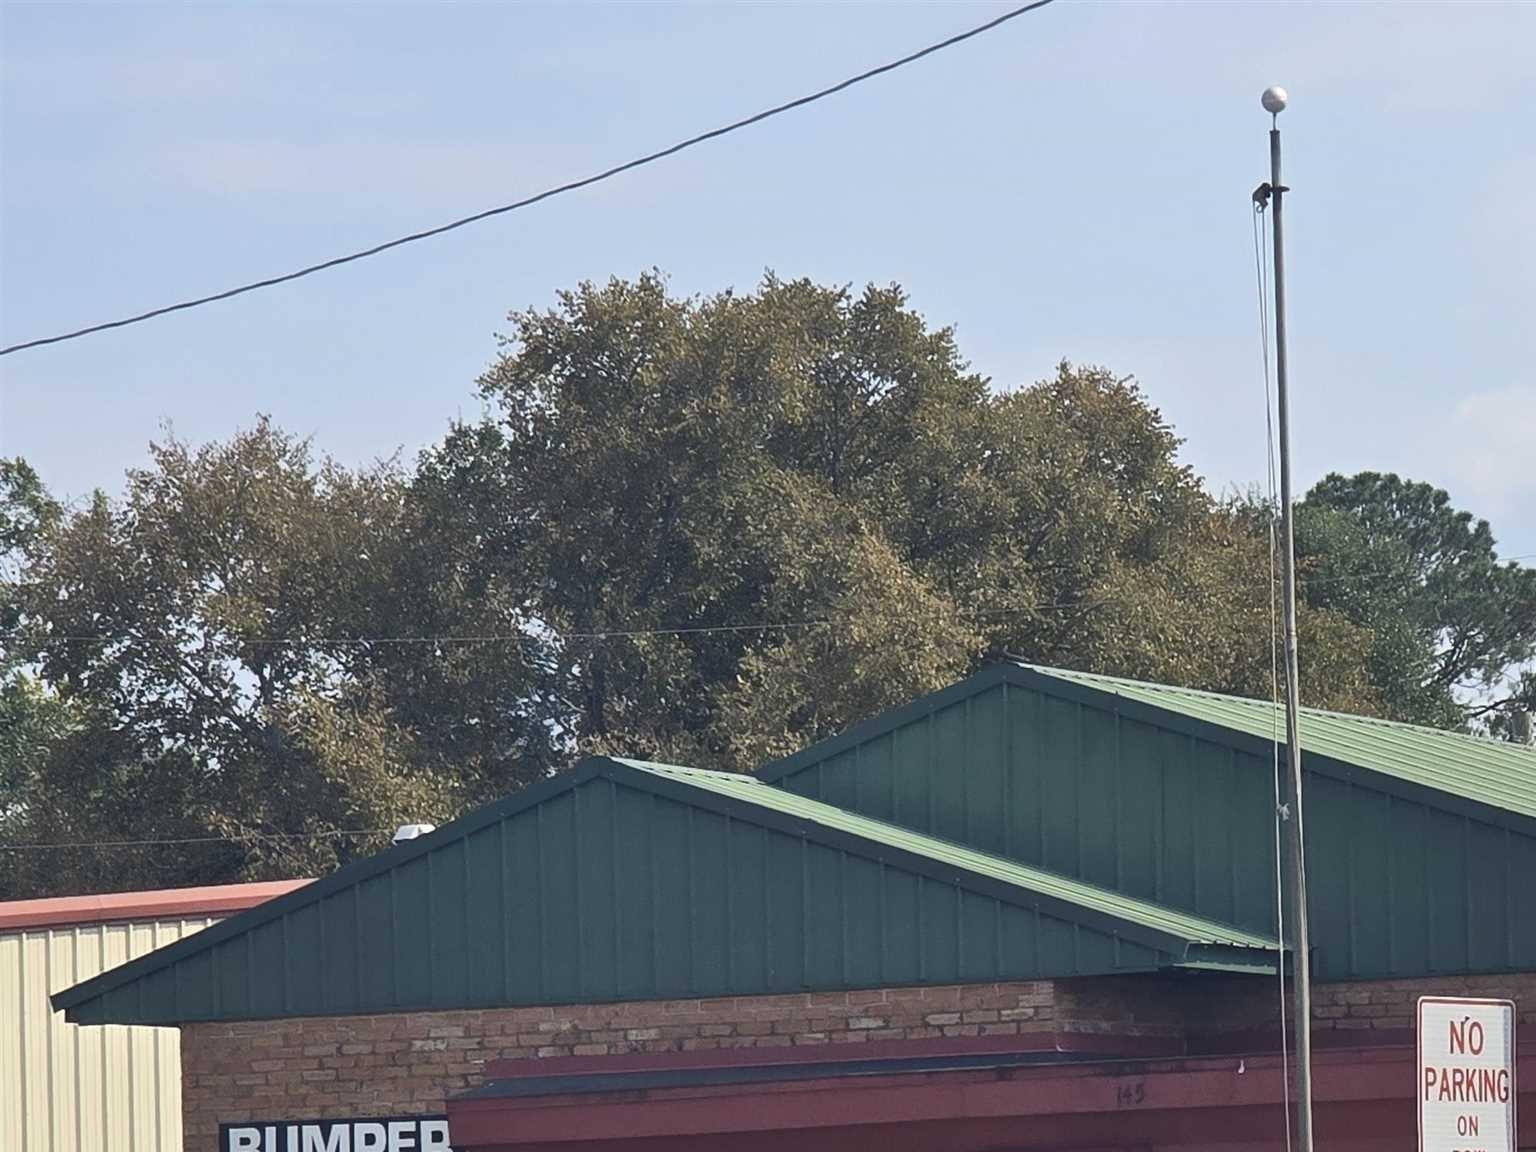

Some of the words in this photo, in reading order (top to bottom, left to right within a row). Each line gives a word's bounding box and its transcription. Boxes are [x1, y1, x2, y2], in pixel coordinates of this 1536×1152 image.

[1449, 1020, 1484, 1055] NO
[1425, 1067, 1509, 1103] PARKING
[1457, 1115, 1478, 1136] ON
